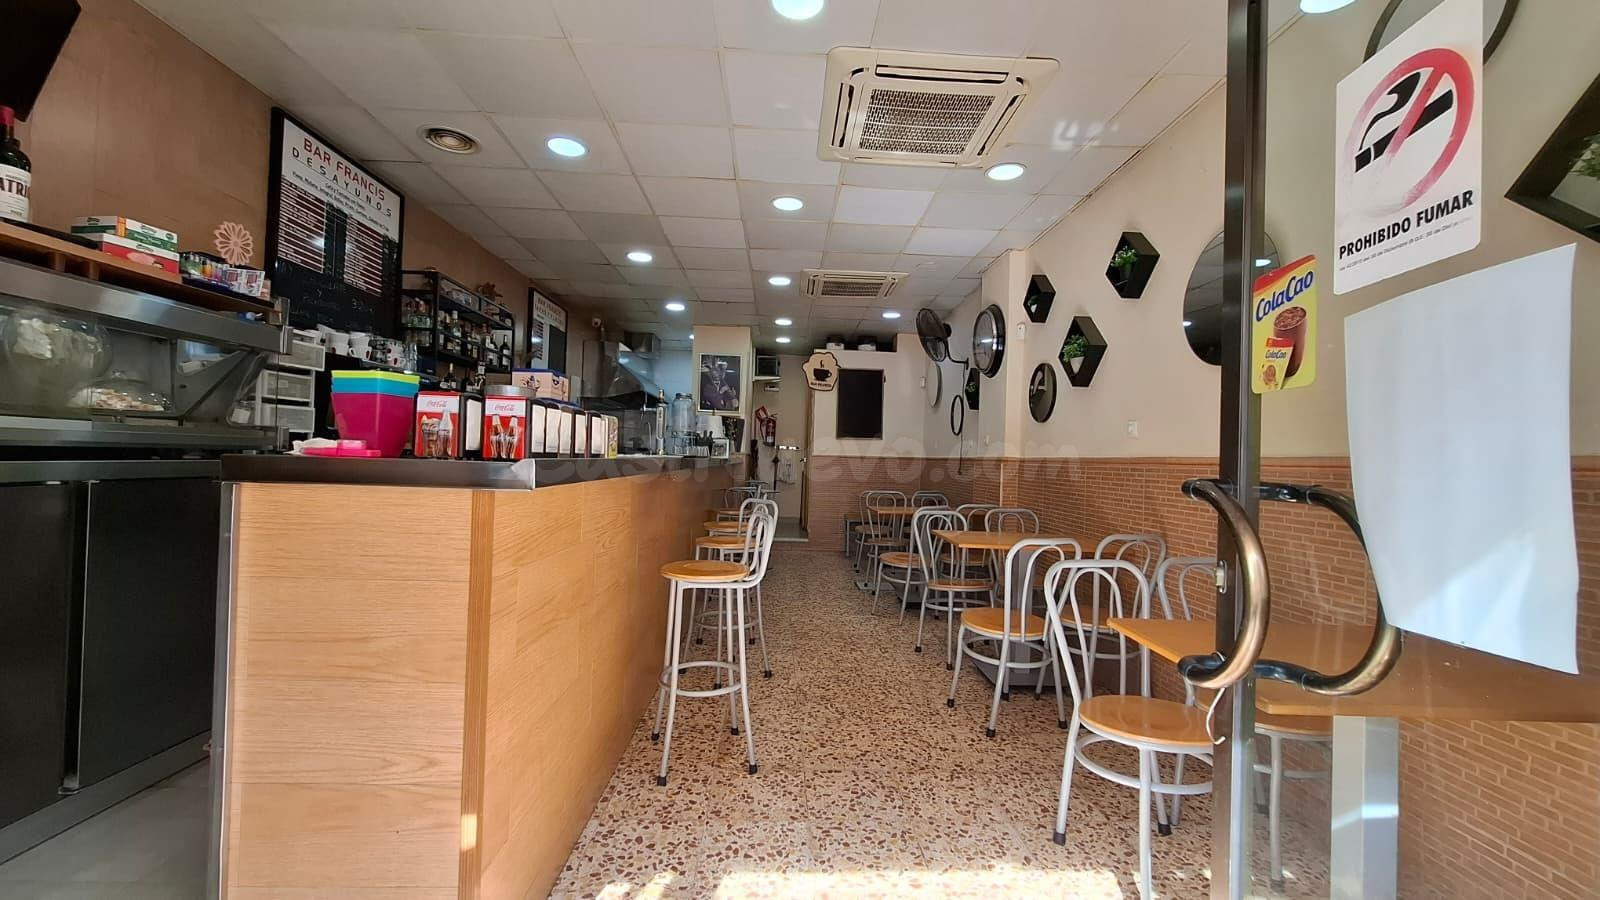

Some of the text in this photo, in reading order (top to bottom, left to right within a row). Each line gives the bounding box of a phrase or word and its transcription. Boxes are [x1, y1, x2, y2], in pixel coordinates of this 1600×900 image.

[292, 147, 392, 217] DESAYUNOS
[304, 138, 331, 166] BAR
[336, 161, 385, 201] FRANCIS
[1339, 217, 1411, 260] PROHIBIDO
[1416, 190, 1474, 227] FUMAR
[1255, 270, 1314, 323] ColaCao
